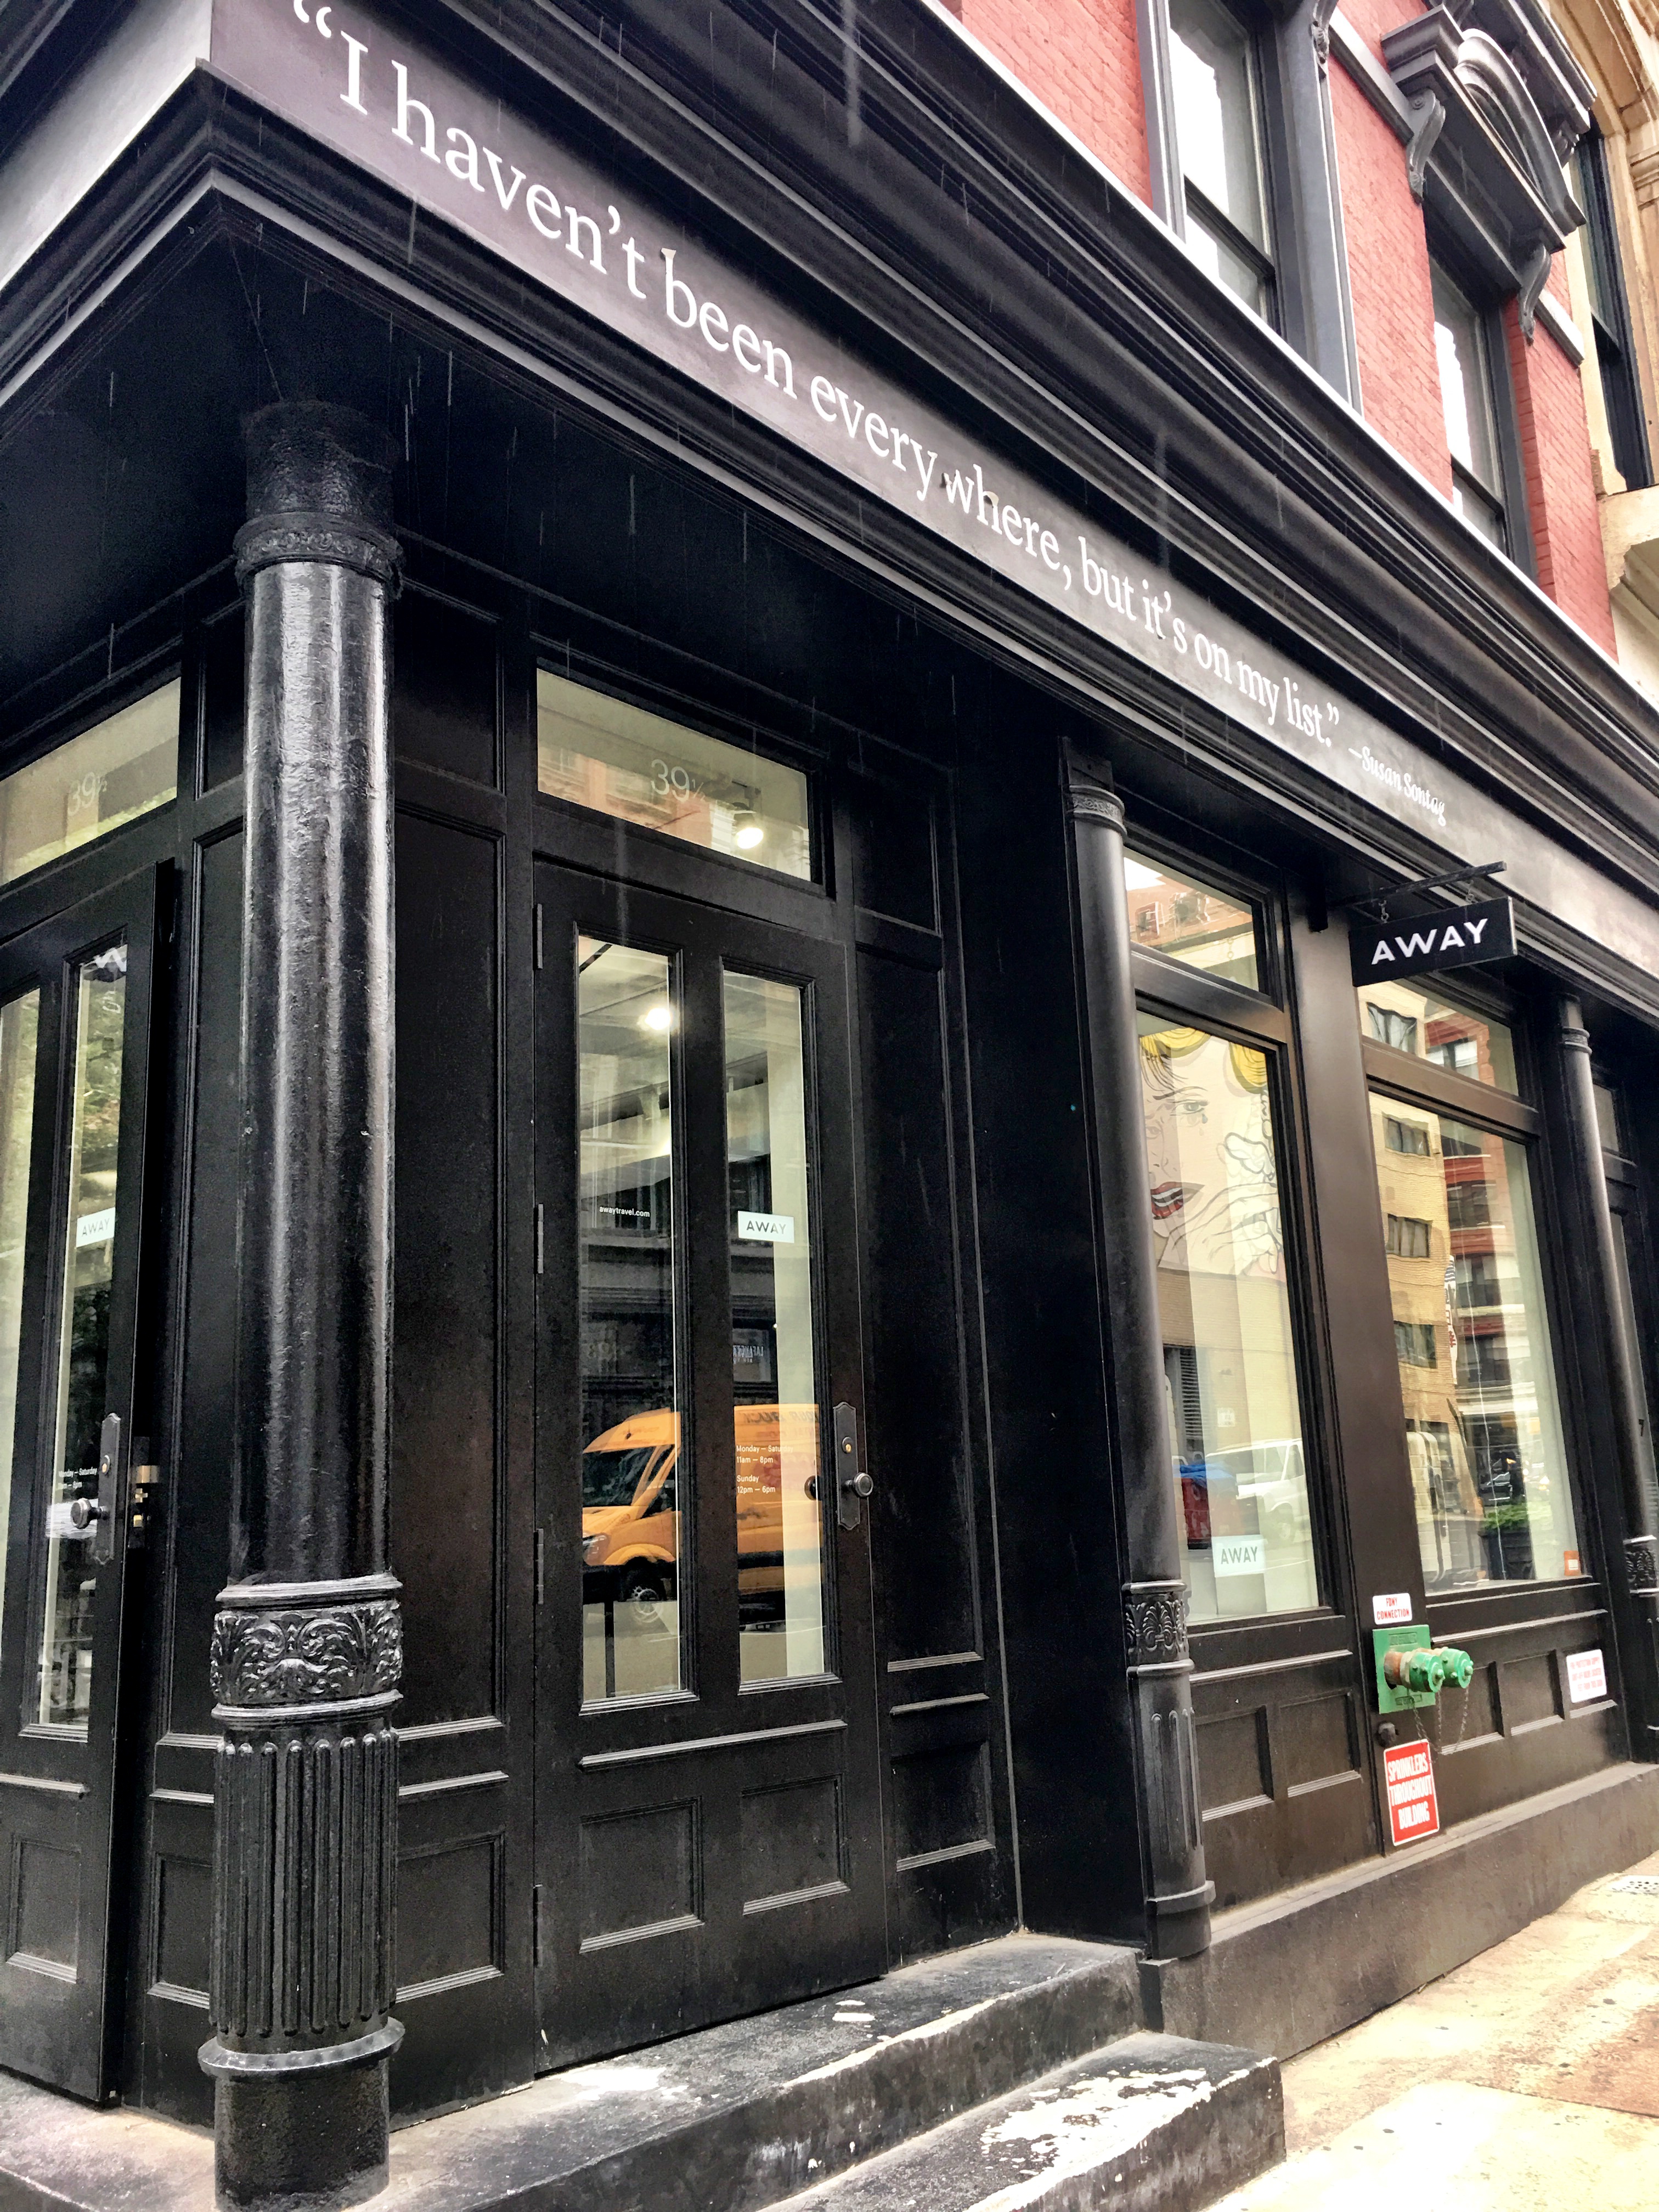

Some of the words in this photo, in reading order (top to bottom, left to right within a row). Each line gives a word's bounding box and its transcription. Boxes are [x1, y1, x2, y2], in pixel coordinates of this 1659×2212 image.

[391, 59, 646, 299] haven't
[661, 247, 797, 399] been
[1078, 535, 1137, 621] but
[1142, 579, 1188, 654] it's
[1194, 633, 1233, 685] on
[1237, 660, 1280, 726] my
[1283, 676, 1340, 748] list."
[1404, 772, 1447, 827] Sontag
[1371, 918, 1488, 966] AWAY
[599, 1206, 651, 1217] awaytravel.com
[81, 1217, 110, 1238] AWAY
[746, 1220, 786, 1234] AWAY
[736, 1444, 760, 1453] Monday
[760, 1456, 774, 1464] 8pm
[736, 1475, 759, 1483] Sunday
[737, 1486, 753, 1494] 12pm
[762, 1485, 776, 1493] 6pm
[1221, 1546, 1258, 1565] AWAY
[1386, 1597, 1398, 1607] FDNY
[1376, 1608, 1410, 1621] CONNECTION
[1387, 1752, 1429, 1782] SPRINKLERS
[1389, 1774, 1432, 1807] THROUGHOUT
[1398, 1797, 1430, 1830] BUILDING
